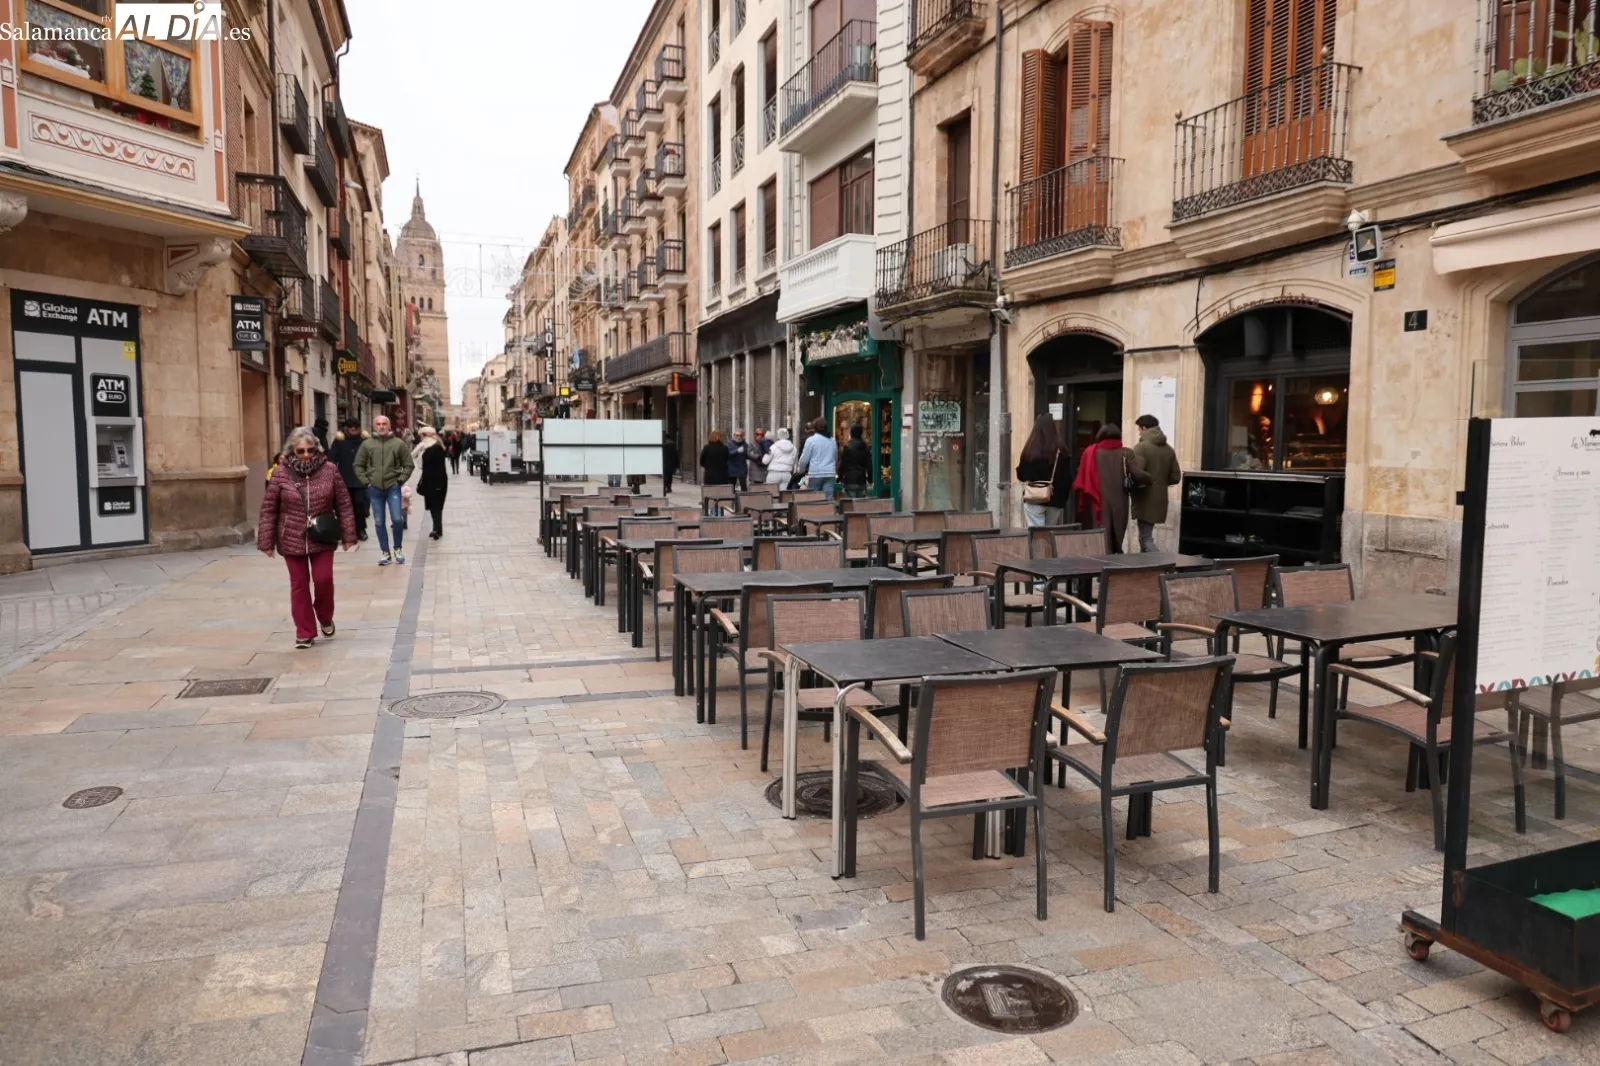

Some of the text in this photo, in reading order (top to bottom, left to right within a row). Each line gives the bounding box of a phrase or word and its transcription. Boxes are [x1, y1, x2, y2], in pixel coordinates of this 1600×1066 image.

[42, 302, 128, 328] Global ATM
[42, 310, 78, 322] Exchange
[1407, 312, 1418, 330] 4
[236, 320, 261, 330] ATM
[545, 319, 553, 385] HOTEL
[97, 379, 125, 391] ATM
